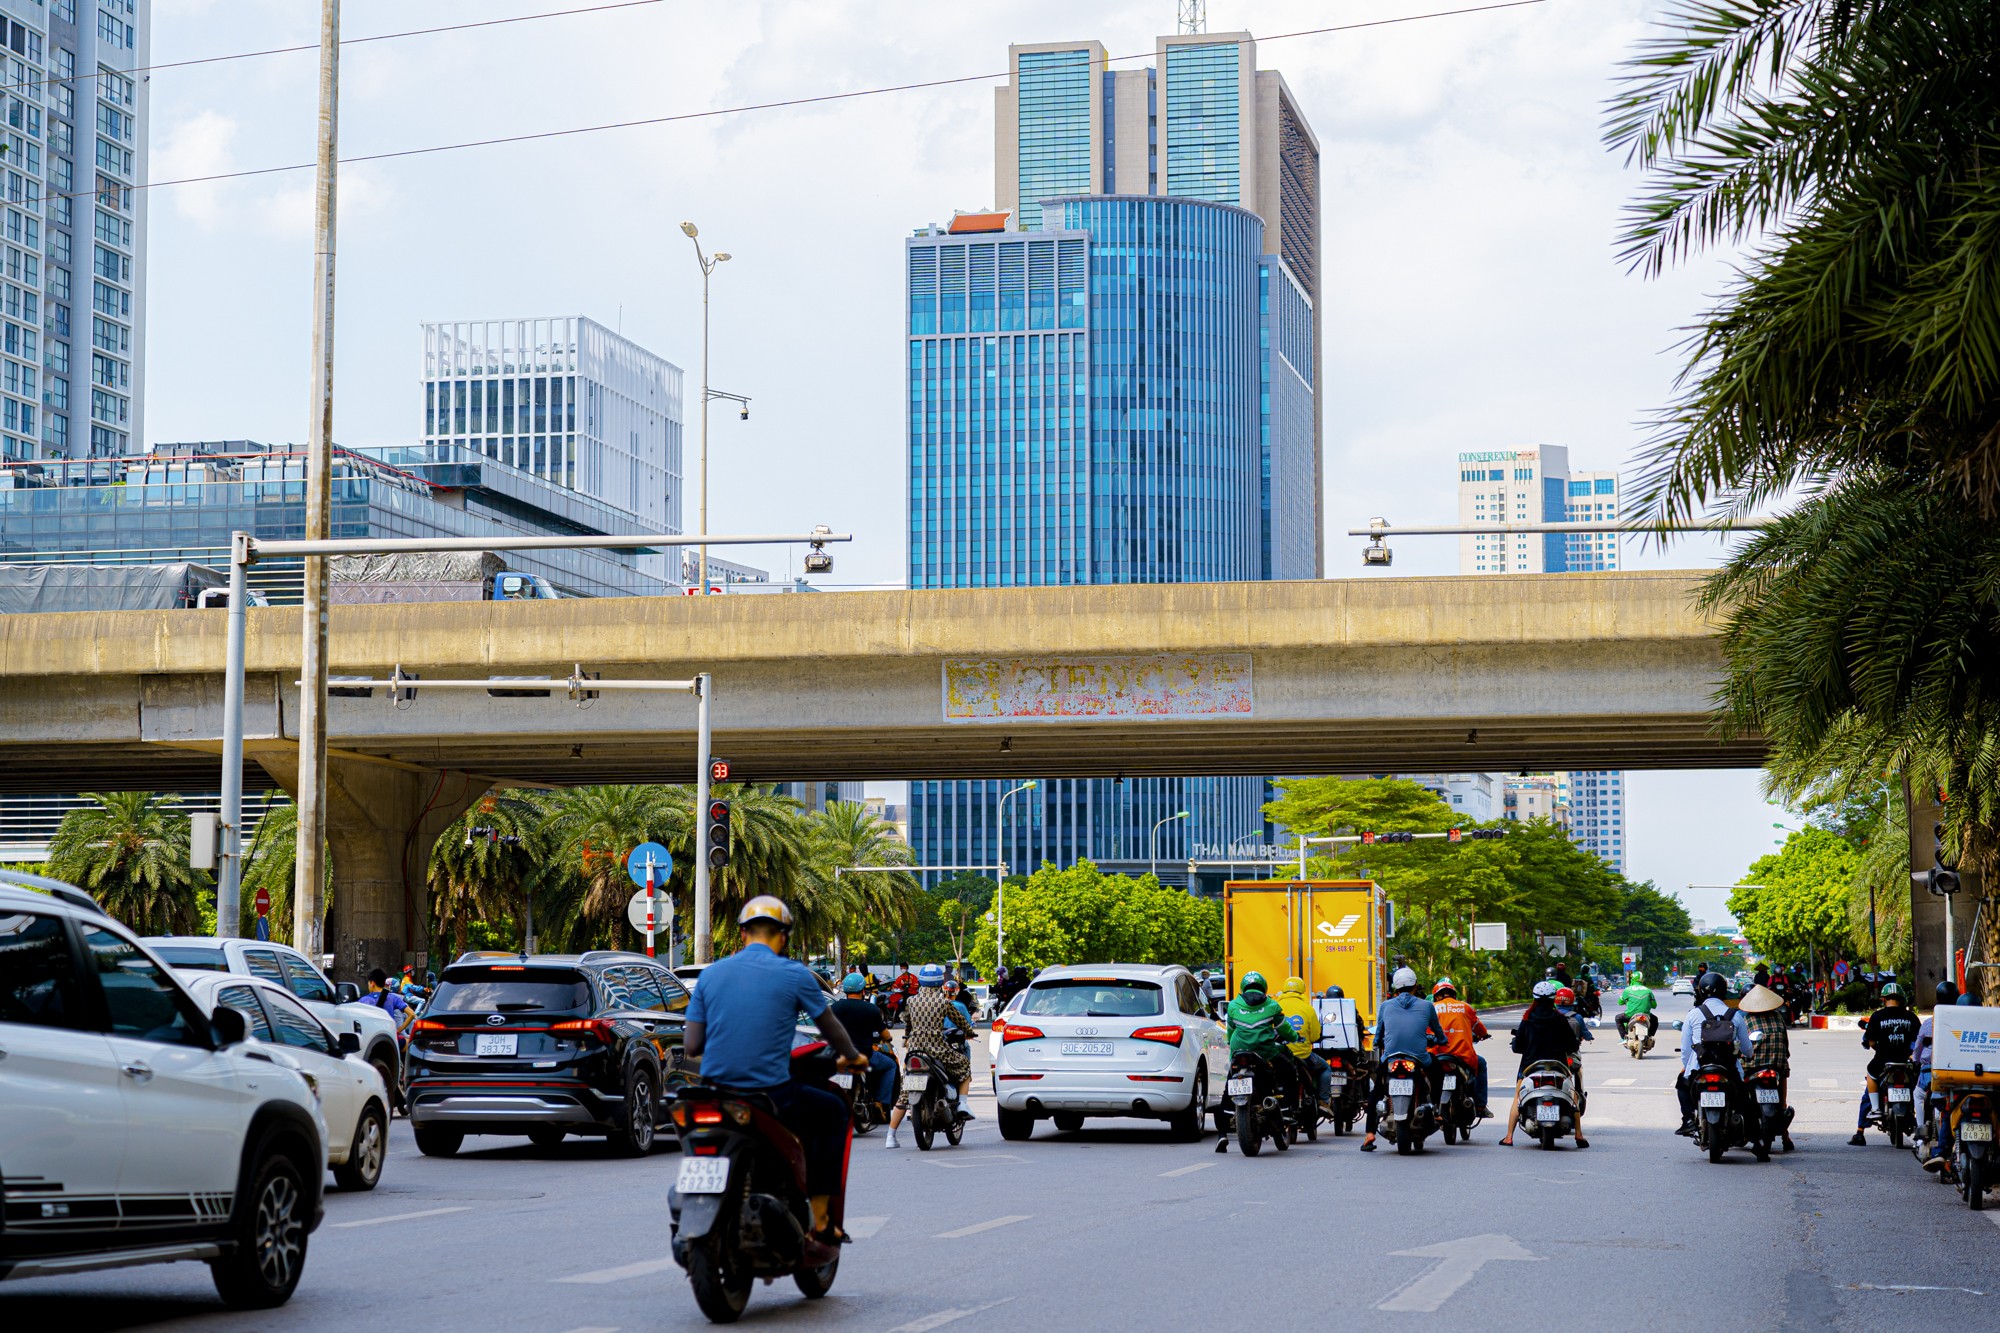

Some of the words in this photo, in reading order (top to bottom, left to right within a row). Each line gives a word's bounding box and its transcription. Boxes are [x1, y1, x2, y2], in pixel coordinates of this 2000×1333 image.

[714, 764, 727, 778] 33
[1193, 843, 1224, 856] THAI
[1228, 844, 1256, 857] NAM
[489, 1035, 506, 1045] 30H
[1961, 1031, 1988, 1044] EMS
[481, 1045, 512, 1054] 383.75
[1062, 1043, 1112, 1053] 30E-205.28
[687, 1161, 720, 1174] 43-C1
[680, 1176, 723, 1191] 682.92
